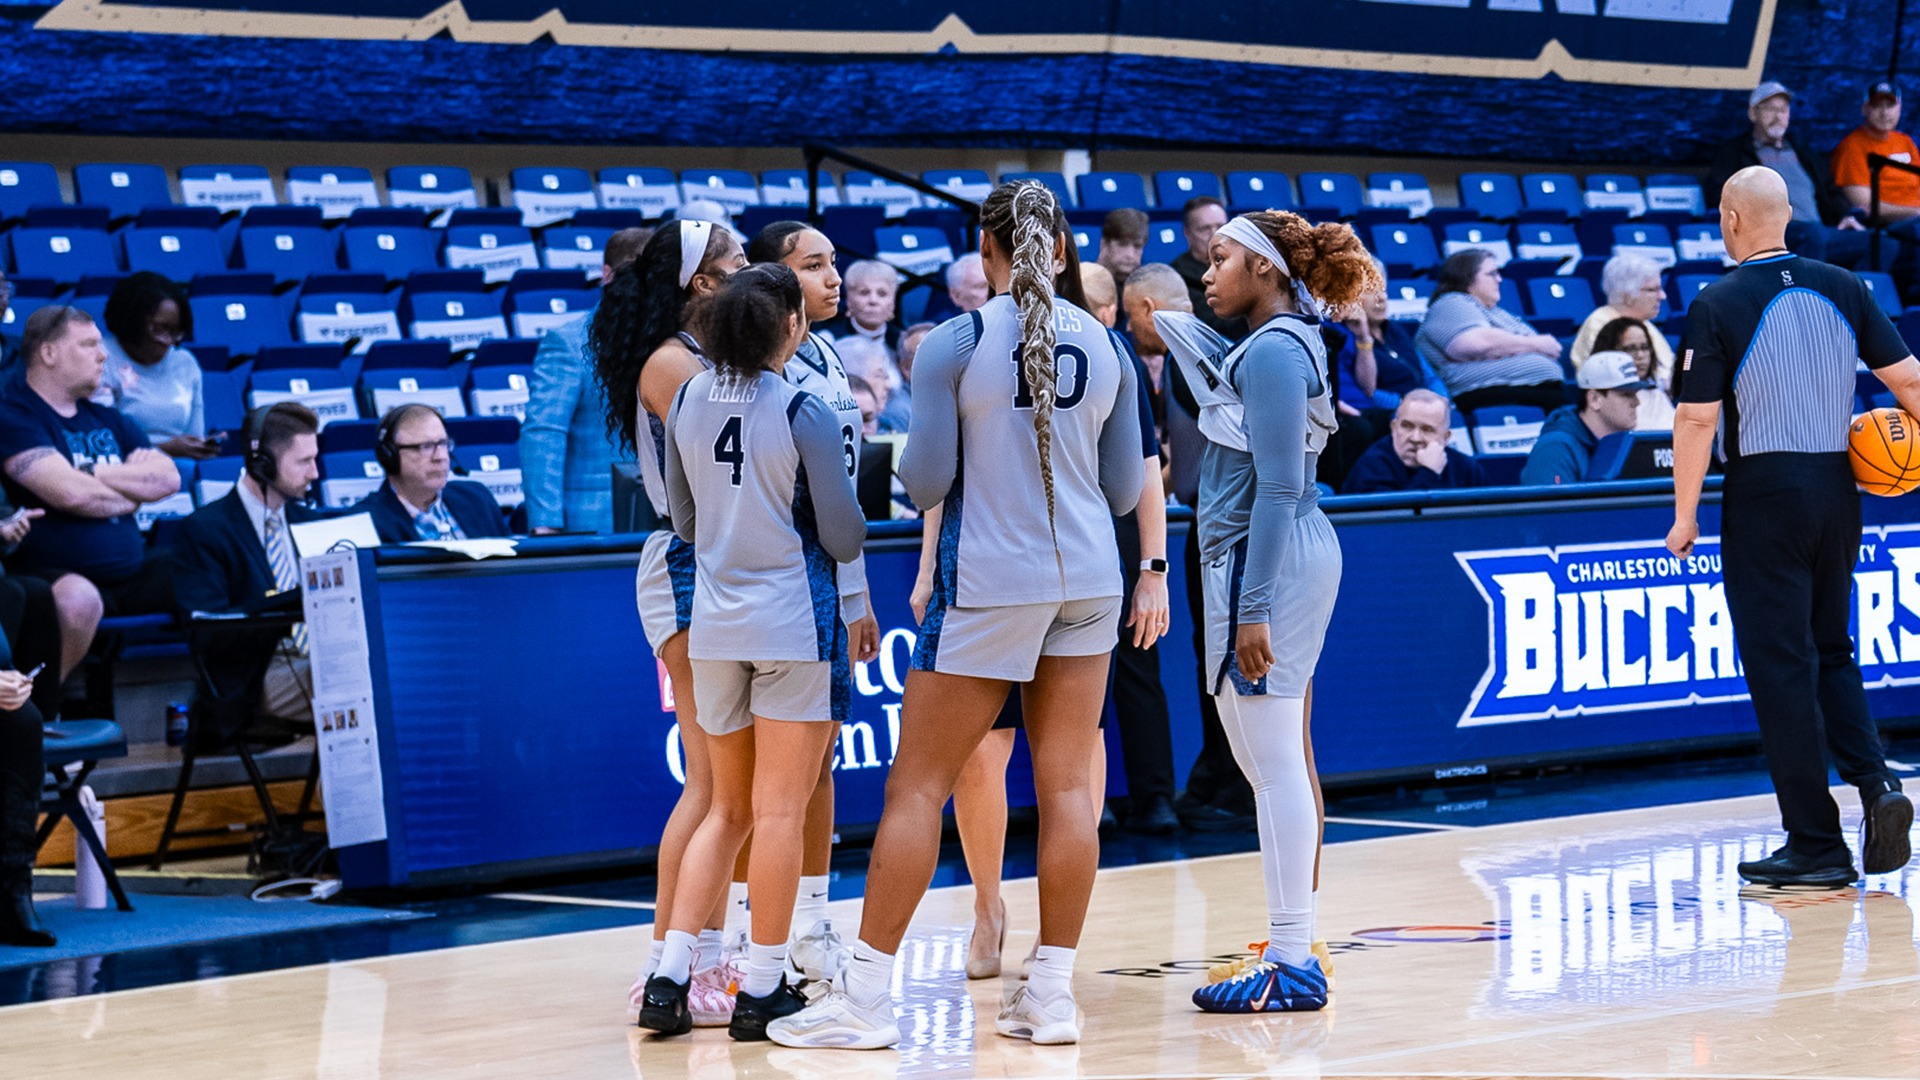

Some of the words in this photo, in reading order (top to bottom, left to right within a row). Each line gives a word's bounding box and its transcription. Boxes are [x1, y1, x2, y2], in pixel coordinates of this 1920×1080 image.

[1010, 340, 1091, 411] 10
[713, 414, 745, 488] 4
[1567, 557, 1682, 583] CHARLESTON
